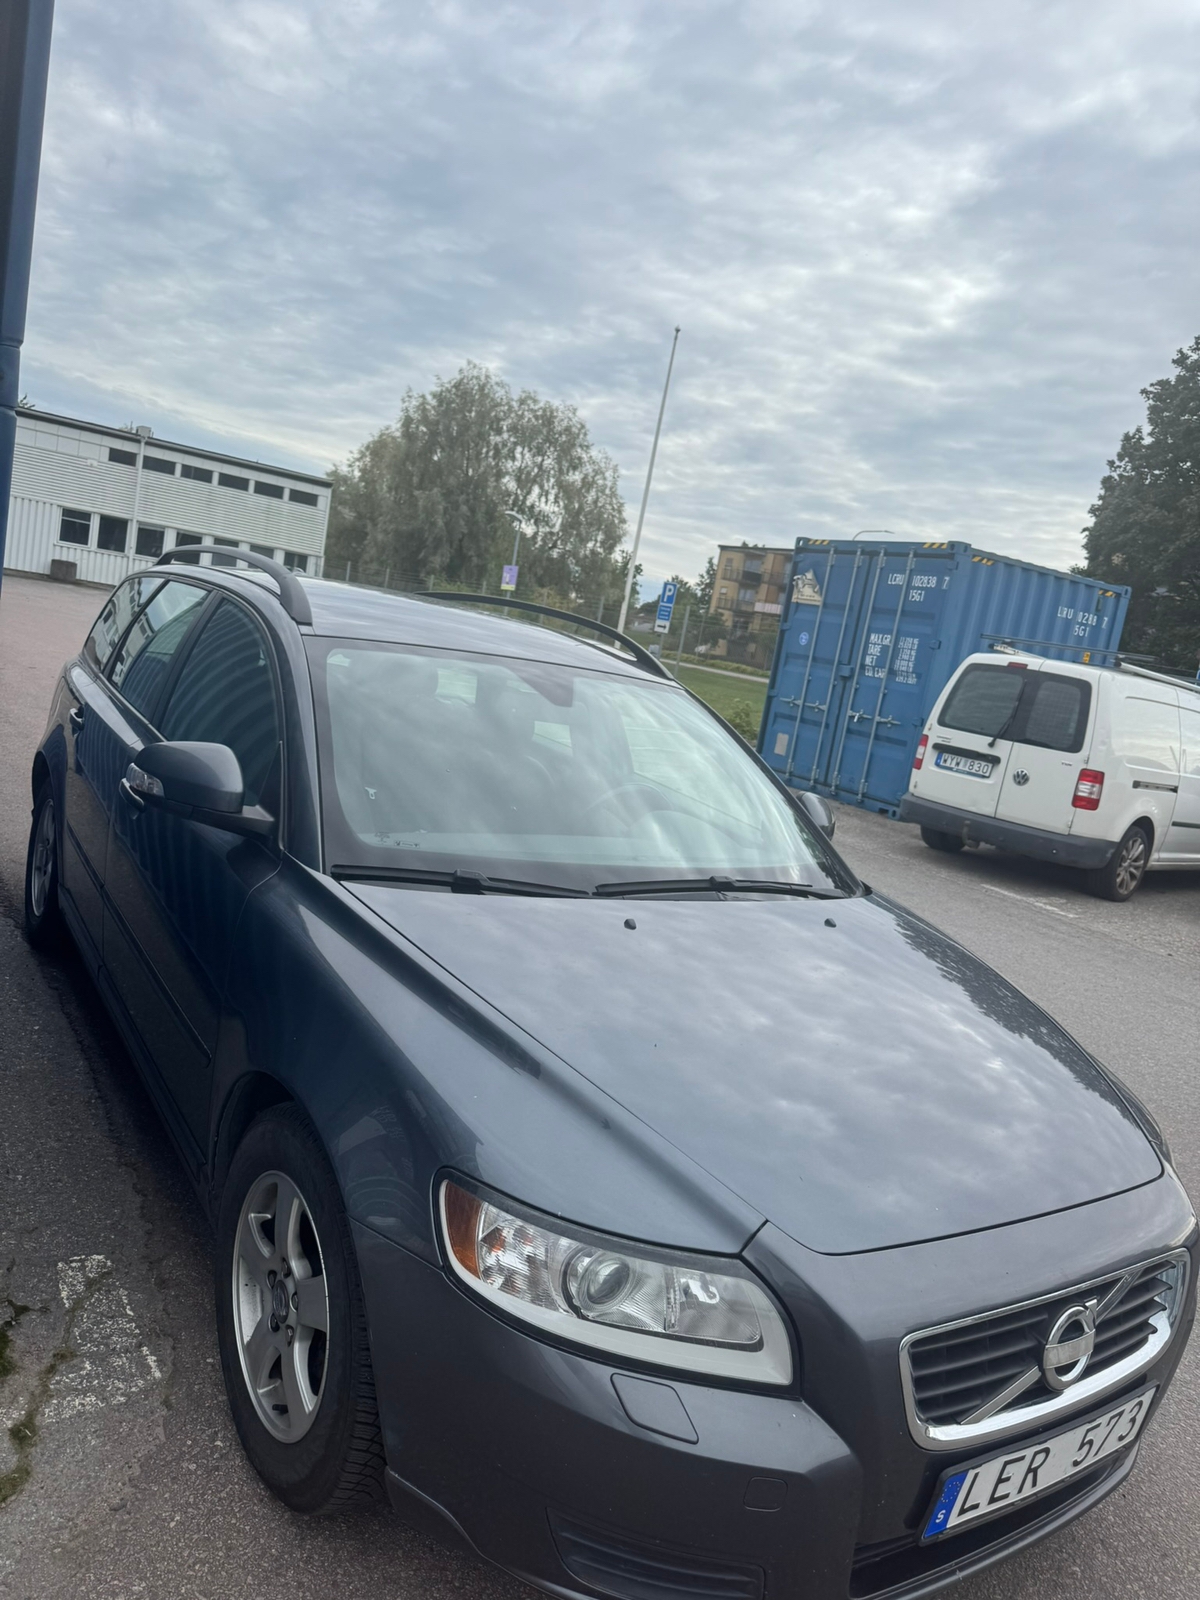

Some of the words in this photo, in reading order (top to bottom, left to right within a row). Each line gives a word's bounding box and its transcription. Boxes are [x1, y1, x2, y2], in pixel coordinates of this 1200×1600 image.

[664, 585, 674, 602] P
[868, 644, 882, 656] TARE
[865, 655, 876, 666] NET
[942, 754, 963, 768] WYW
[968, 760, 990, 774] 830
[956, 1445, 1051, 1517] LER
[1072, 1399, 1145, 1468] 573
[935, 1509, 946, 1524] S
